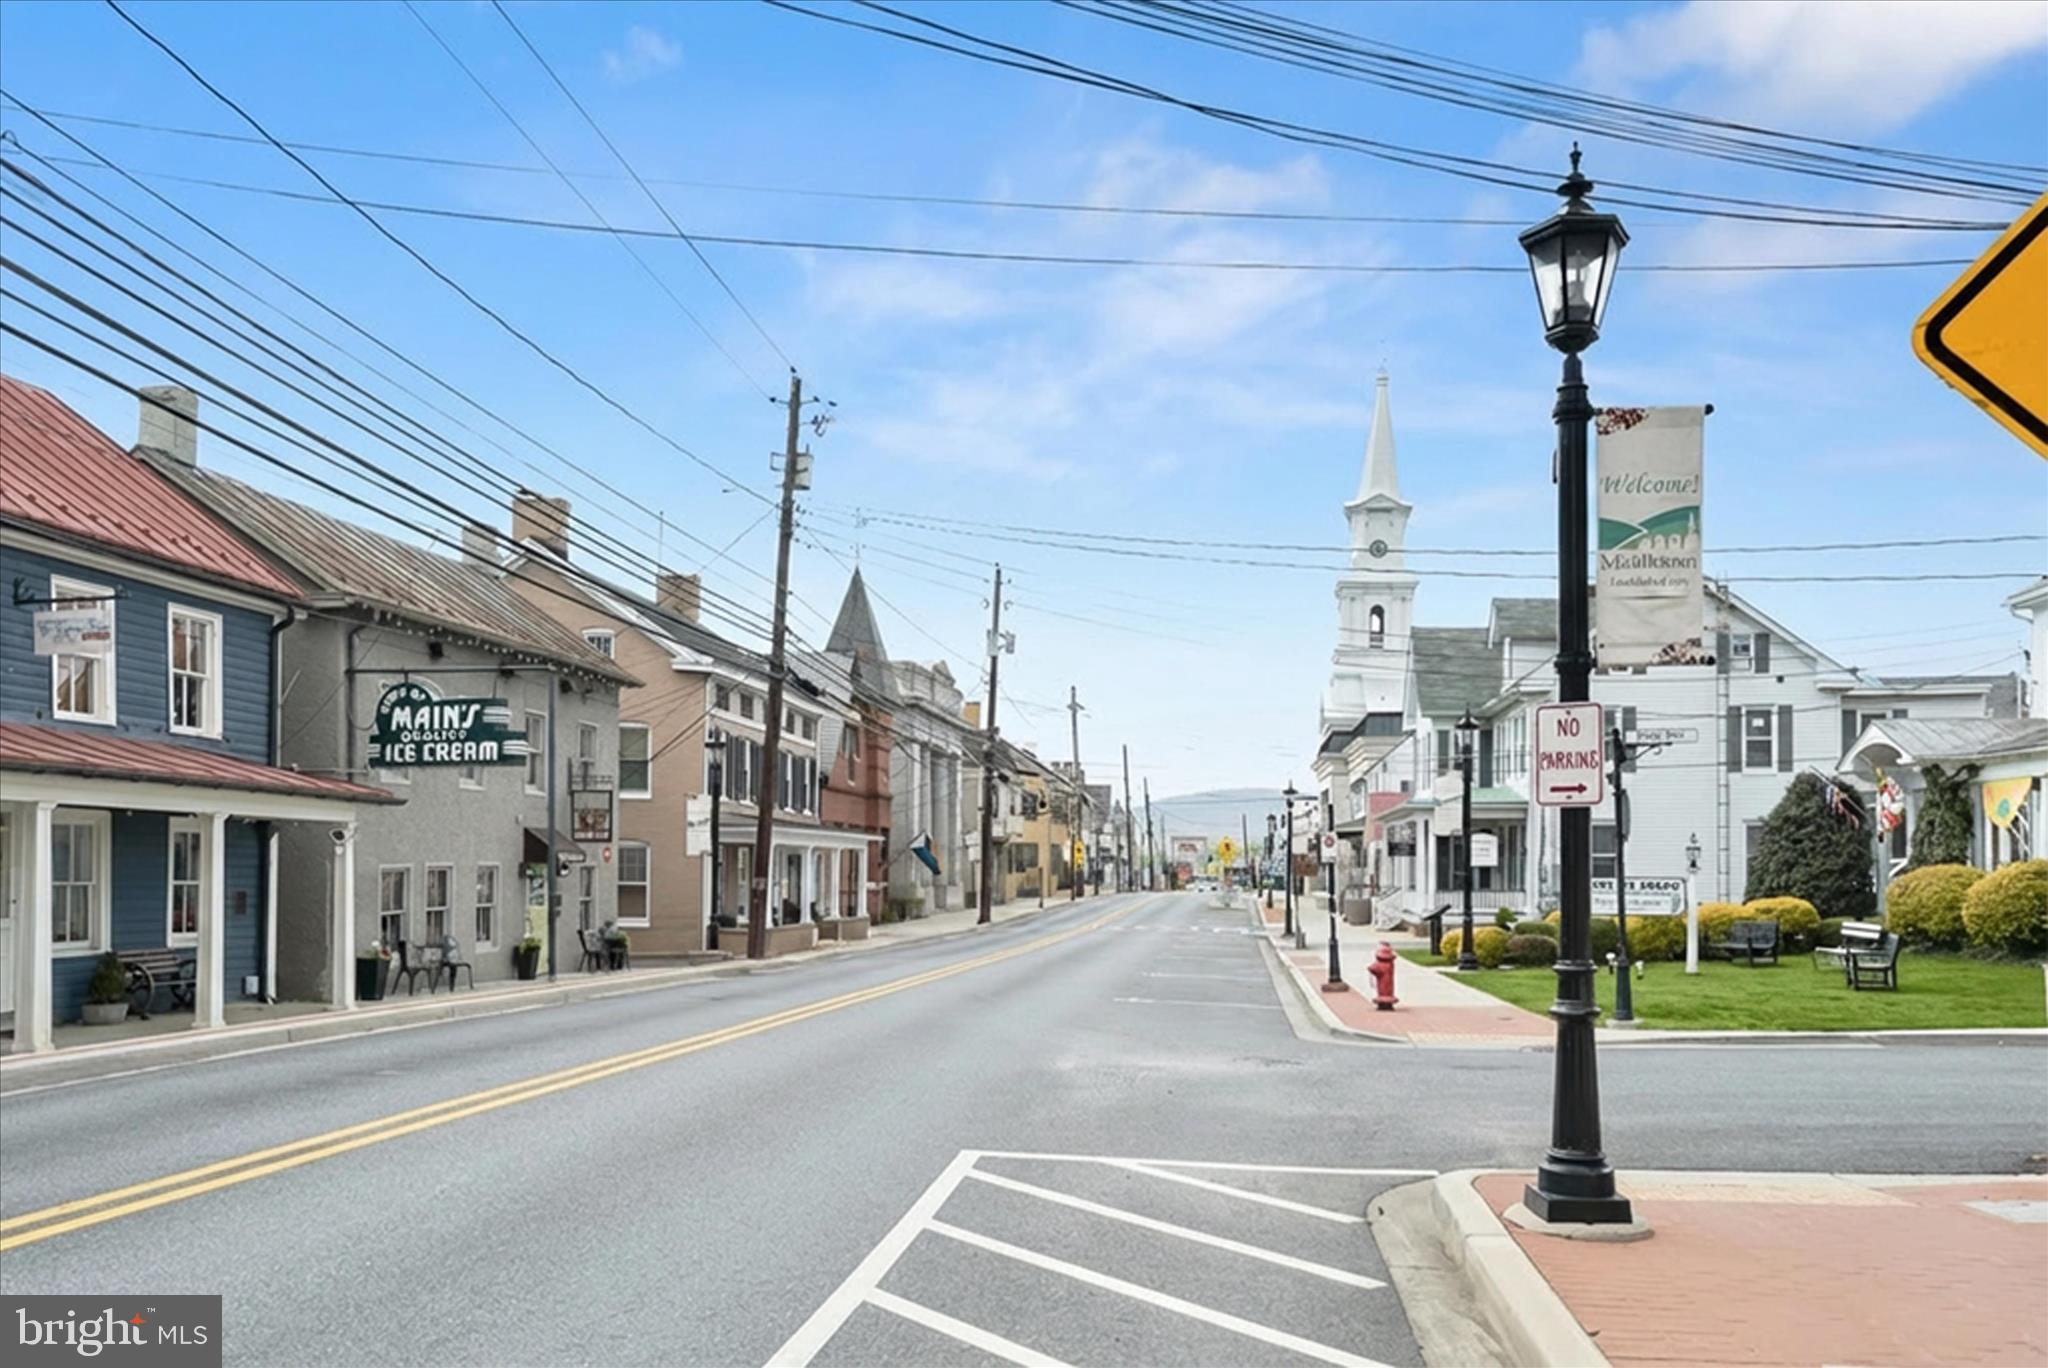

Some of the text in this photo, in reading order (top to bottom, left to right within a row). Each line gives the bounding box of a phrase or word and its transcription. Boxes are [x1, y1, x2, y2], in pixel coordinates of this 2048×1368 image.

[390, 703, 481, 732] MAIN'S
[1557, 717, 1580, 738] NO
[385, 740, 499, 763] ICE CREAM
